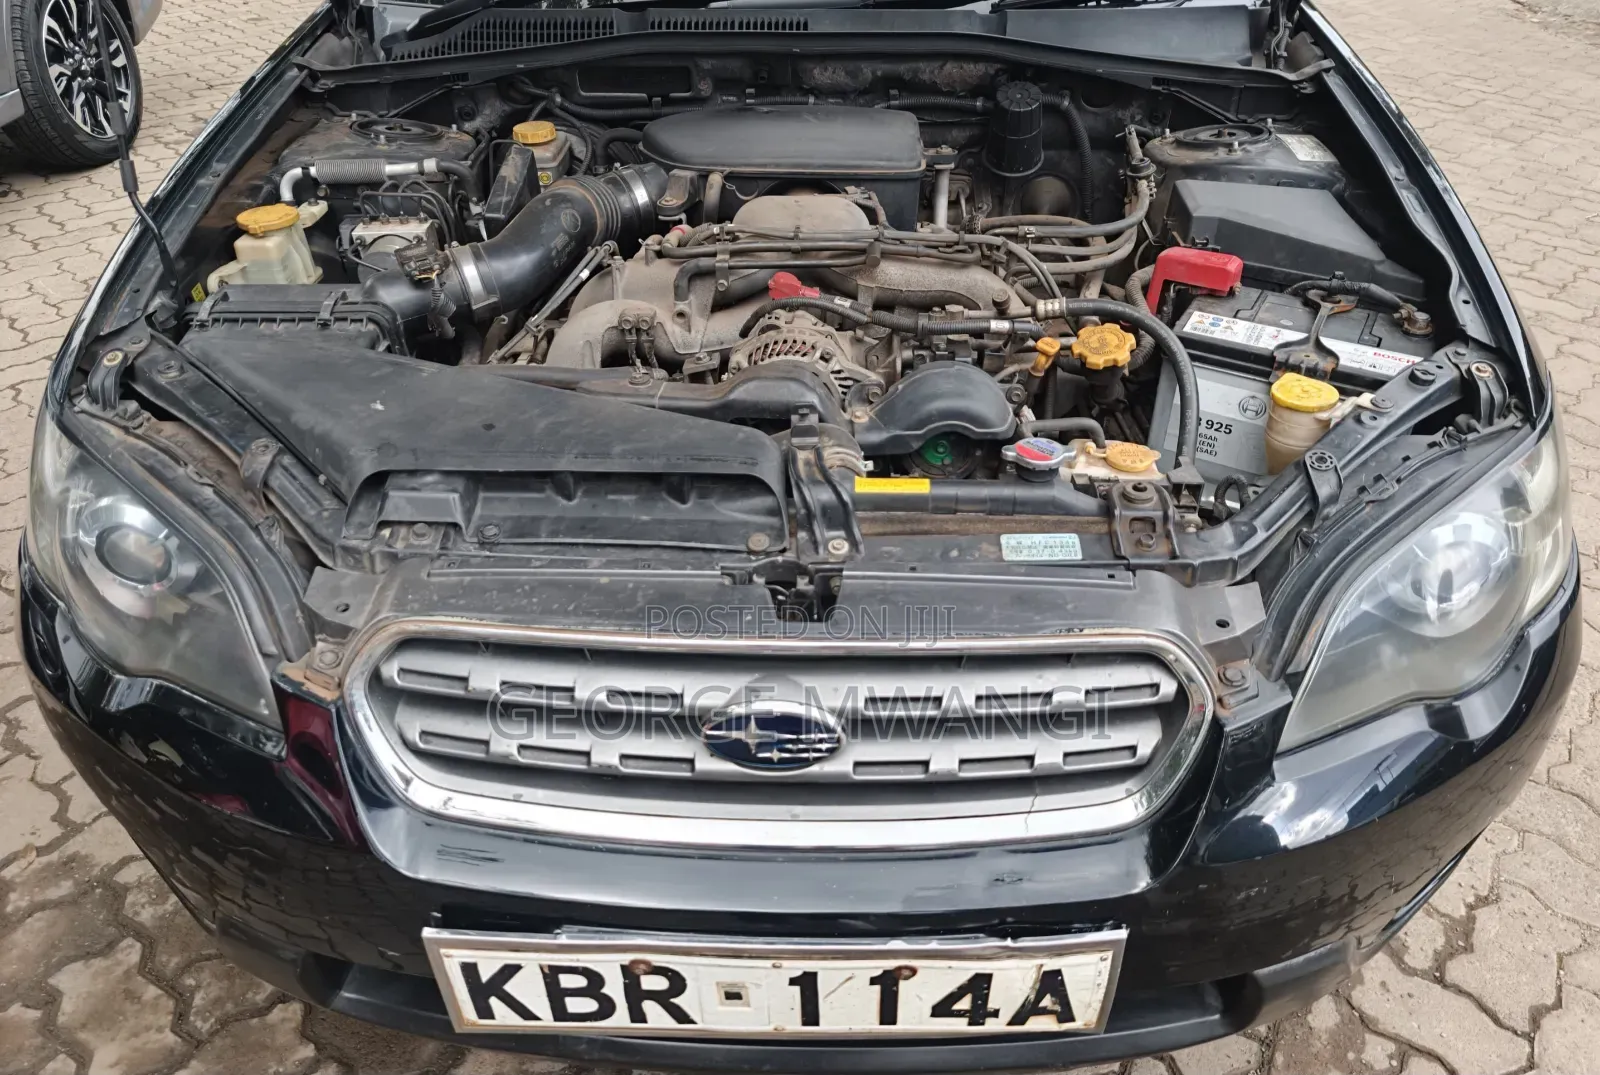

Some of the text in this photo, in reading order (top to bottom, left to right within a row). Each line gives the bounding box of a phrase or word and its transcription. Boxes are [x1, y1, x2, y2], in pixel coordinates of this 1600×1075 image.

[1373, 351, 1416, 366] BOSCH
[1205, 419, 1233, 435] 925
[1198, 432, 1218, 443] 65Ah
[1198, 440, 1216, 449] (EN)
[1196, 446, 1218, 457] (SAE)
[459, 961, 1077, 1027] KBR 114A
